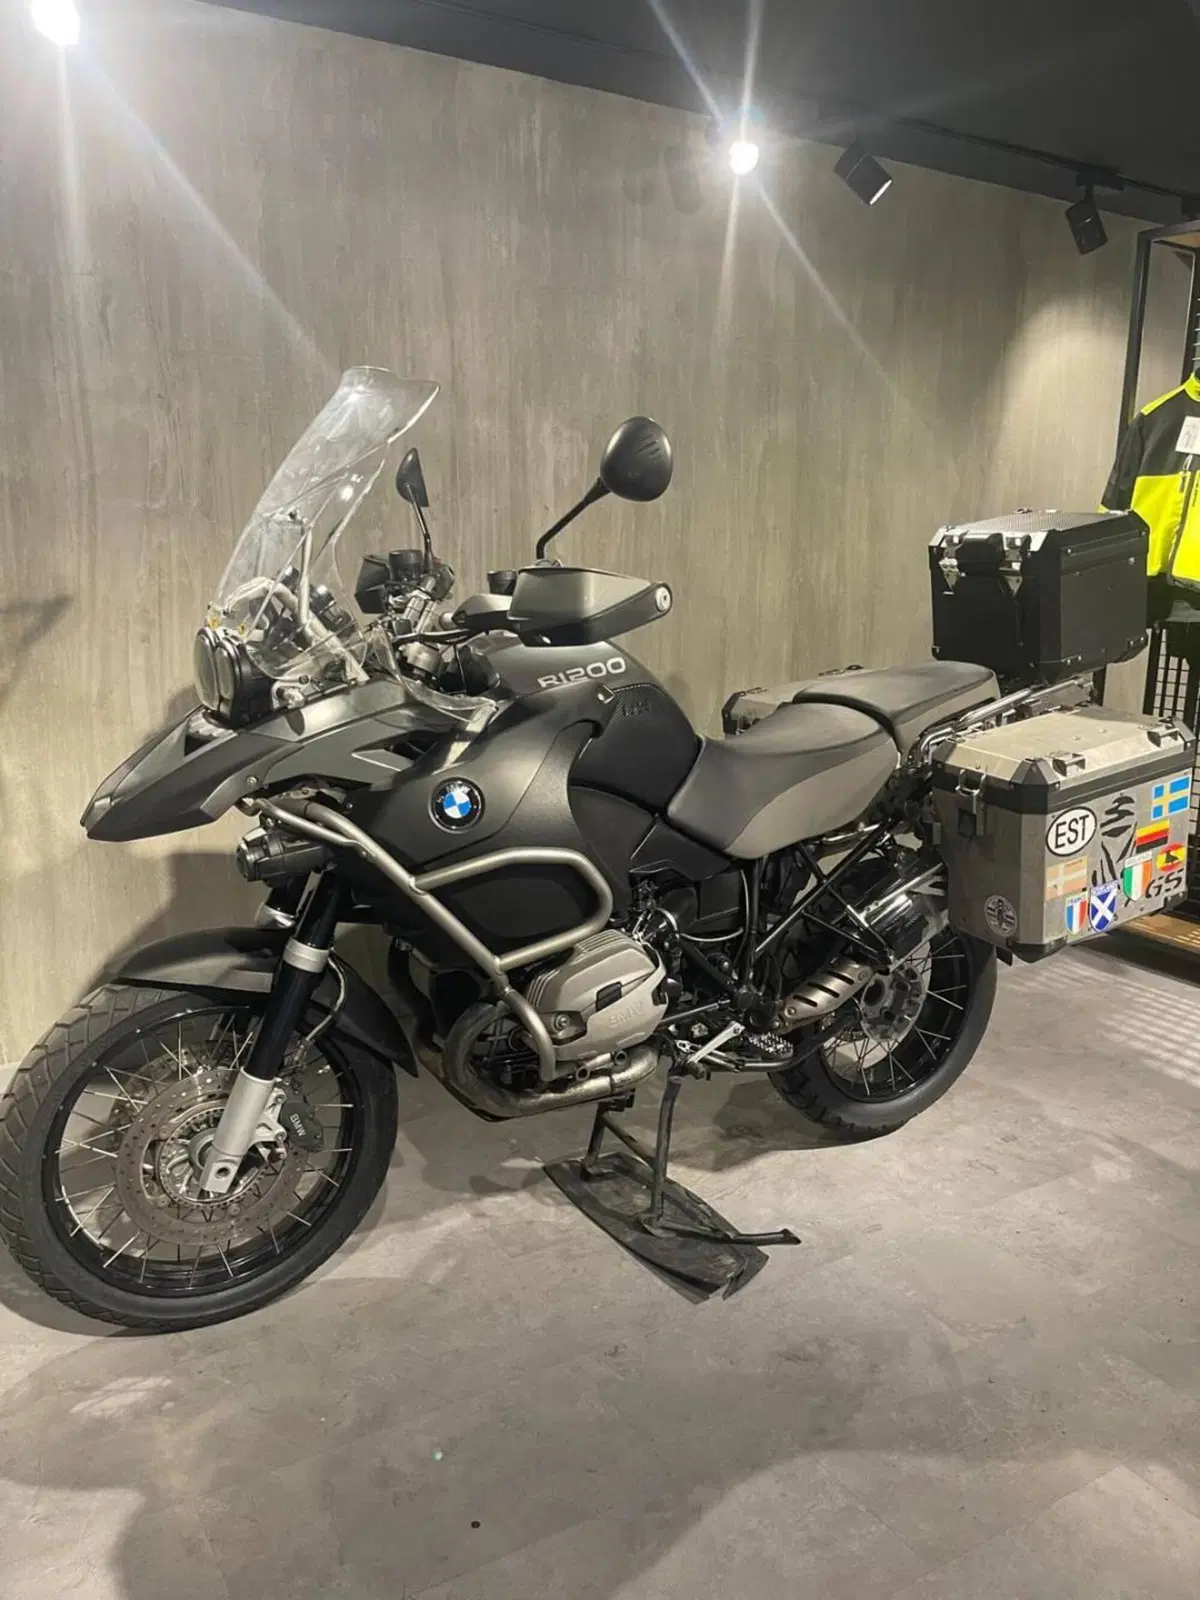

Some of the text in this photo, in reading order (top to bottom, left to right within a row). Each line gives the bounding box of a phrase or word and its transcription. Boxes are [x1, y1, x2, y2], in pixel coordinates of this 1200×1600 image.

[537, 657, 626, 688] R1200
[1055, 814, 1090, 849] EST
[1145, 867, 1185, 898] GS
[290, 1113, 307, 1137] BMW
